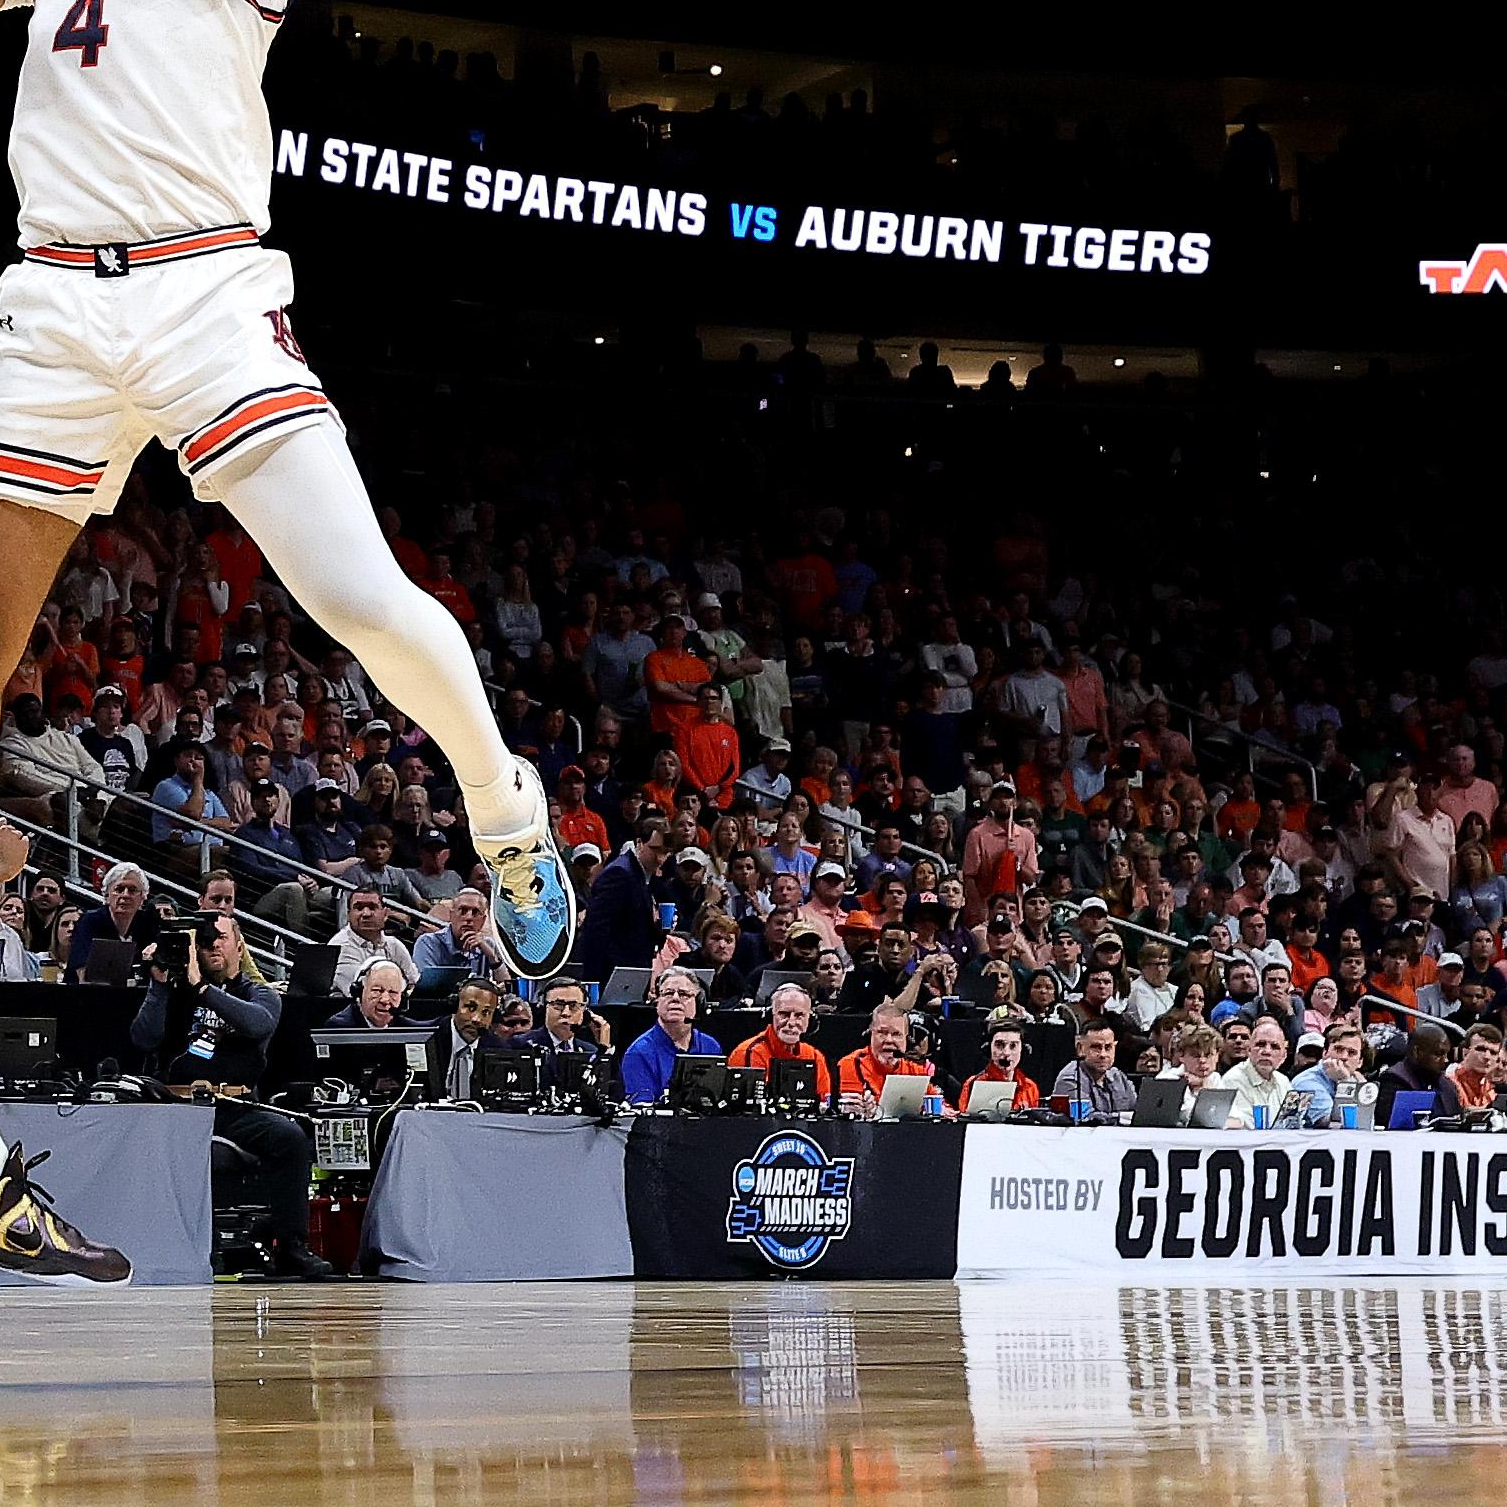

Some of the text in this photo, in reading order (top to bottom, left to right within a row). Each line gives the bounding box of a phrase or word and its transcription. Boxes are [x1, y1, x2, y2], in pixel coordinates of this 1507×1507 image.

[271, 128, 1211, 275] N STATE SPARTANS VS AUBURN TIGERS
[755, 1168, 820, 1196] MARCH
[764, 1197, 847, 1225] MADNESS
[990, 1176, 1068, 1212] HOSTED
[1073, 1178, 1104, 1212] BY
[1115, 1147, 1395, 1259] GEORGIA
